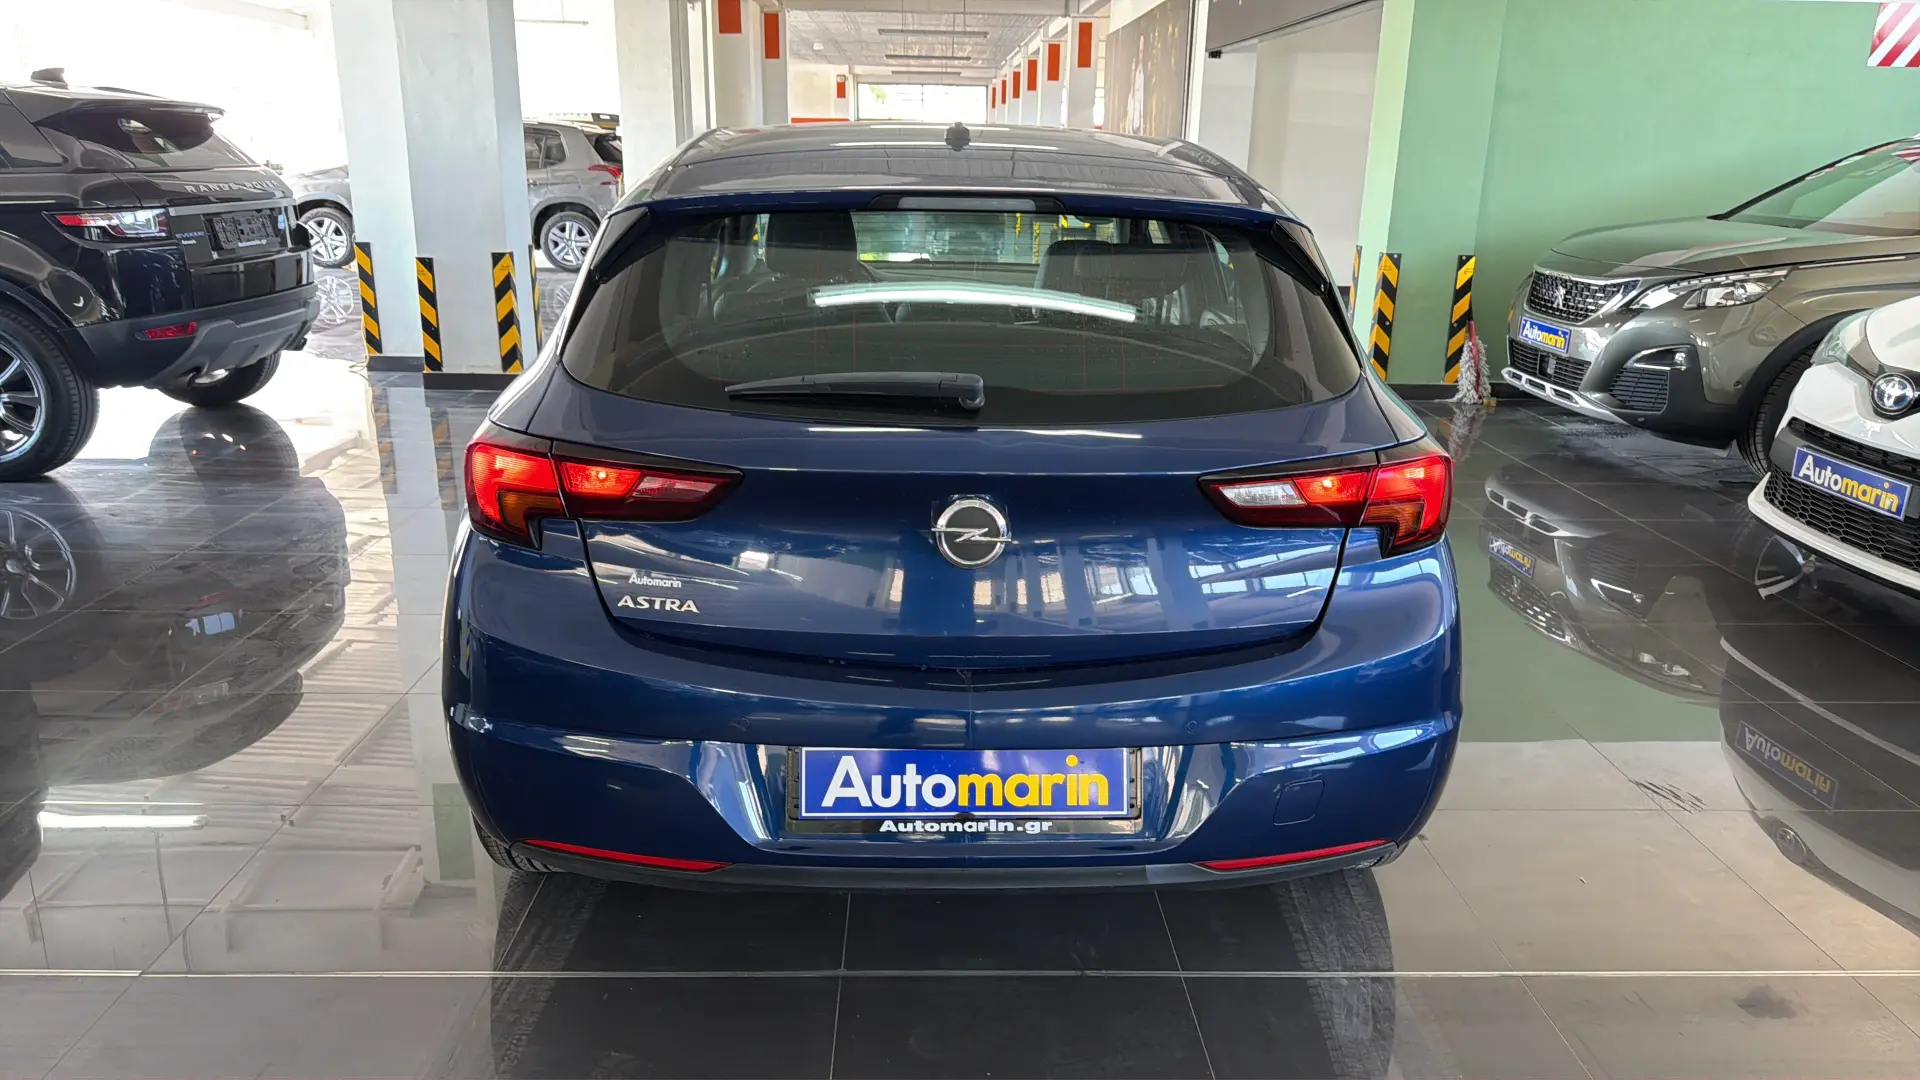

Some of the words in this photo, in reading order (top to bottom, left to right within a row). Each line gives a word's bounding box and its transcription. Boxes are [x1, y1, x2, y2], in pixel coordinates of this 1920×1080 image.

[184, 183, 239, 193] RANGE
[1522, 320, 1565, 349] Automarin
[1798, 454, 1899, 512] Automarin
[628, 573, 681, 588] Automarin
[617, 595, 700, 613] ASTRA
[821, 755, 1109, 807] Automarin
[879, 820, 1053, 834] Automarin.gr
